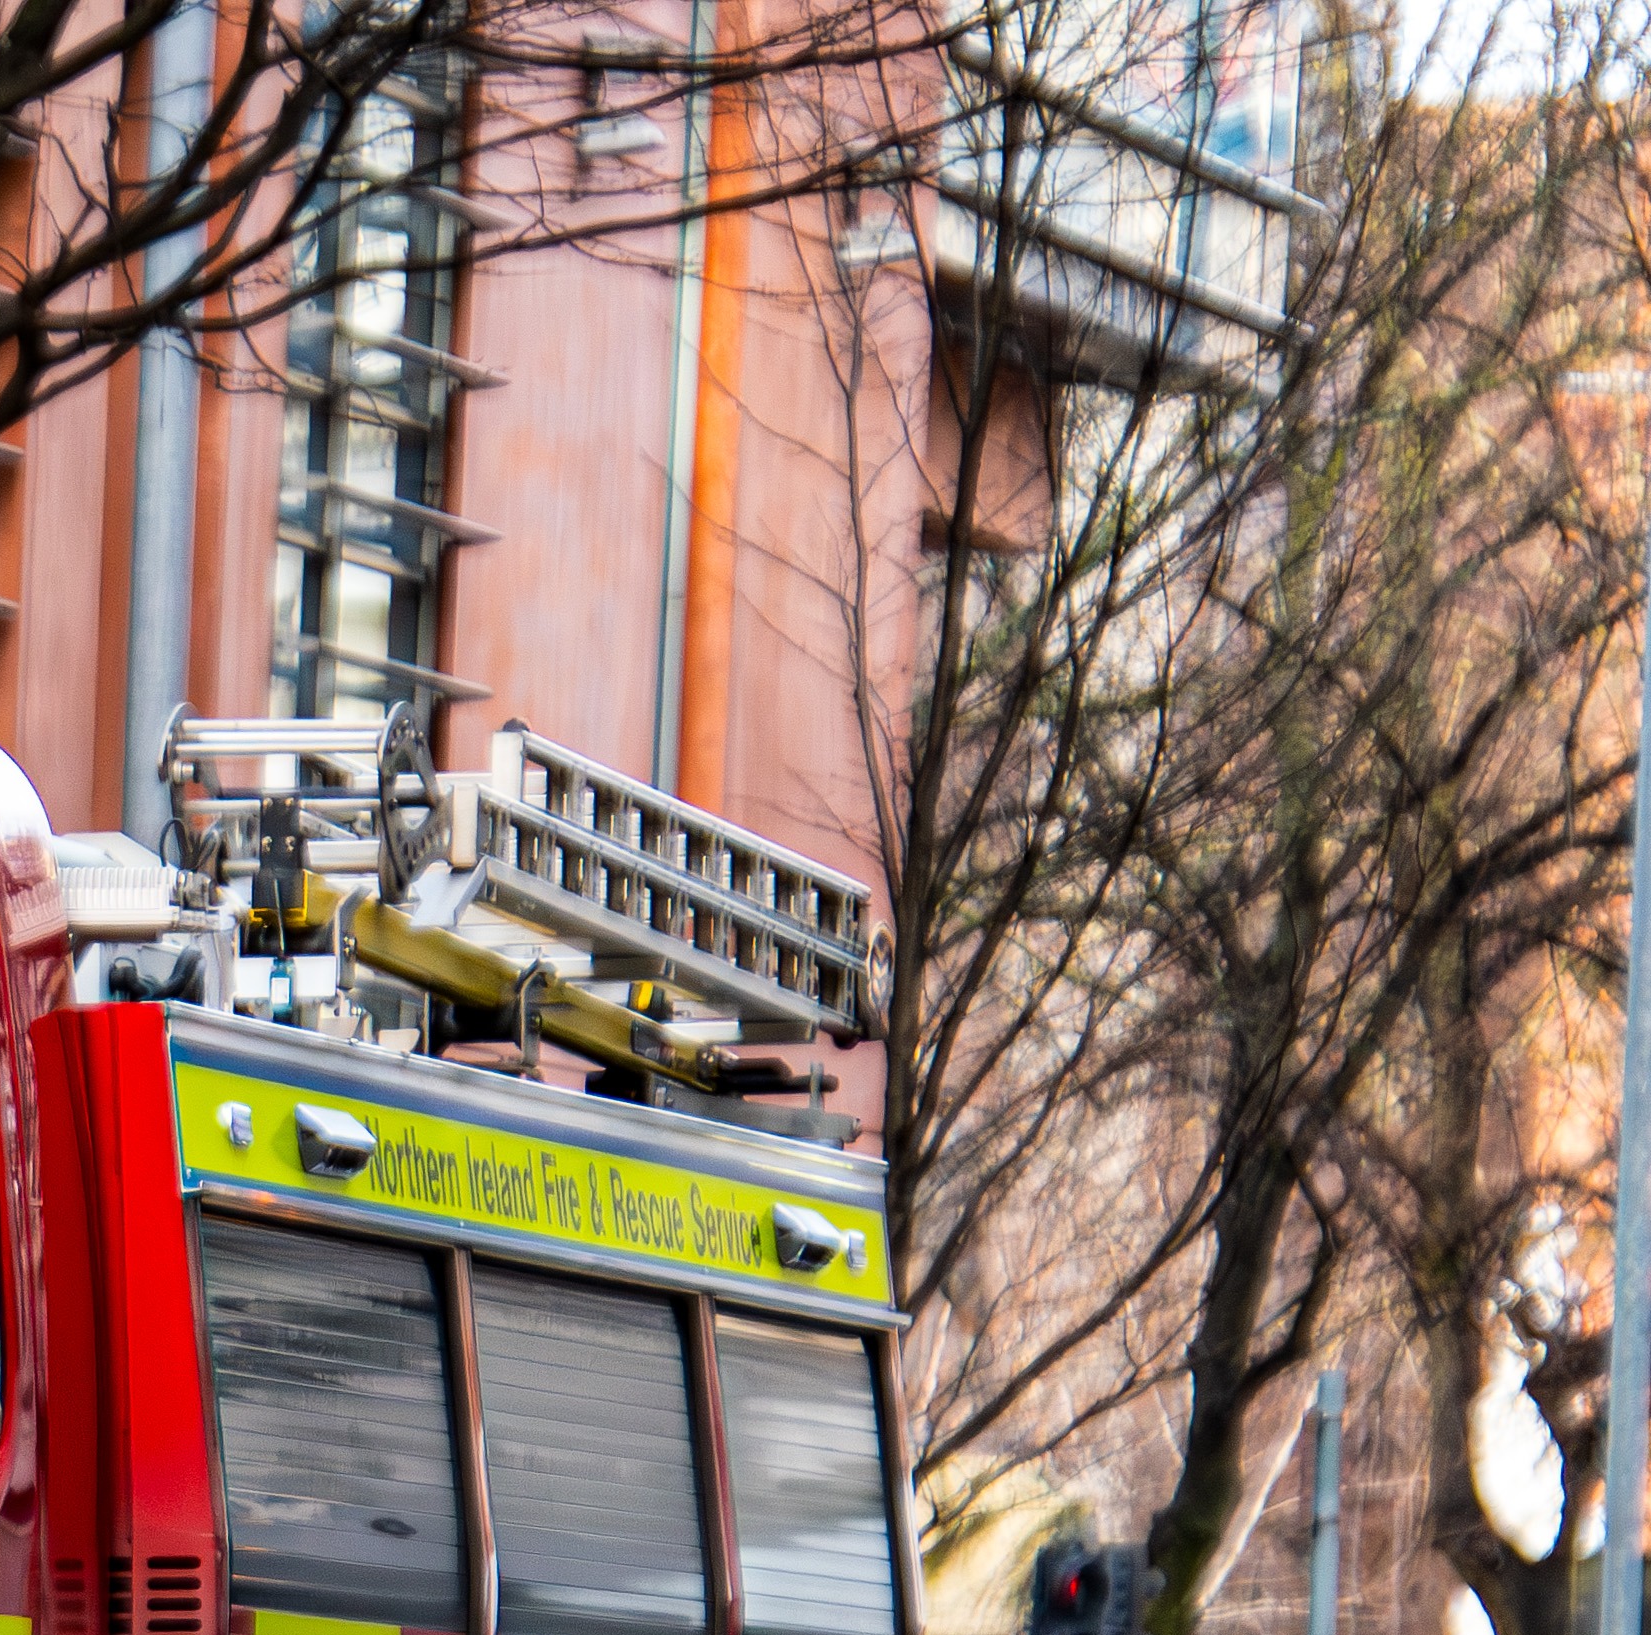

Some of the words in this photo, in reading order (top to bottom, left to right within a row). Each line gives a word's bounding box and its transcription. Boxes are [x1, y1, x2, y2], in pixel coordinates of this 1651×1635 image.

[364, 1115, 462, 1208] Northern
[465, 1135, 538, 1223] Ireland
[541, 1151, 581, 1232] Fire
[588, 1161, 606, 1236] &
[609, 1166, 685, 1253] Rescue
[690, 1182, 763, 1269] Service
